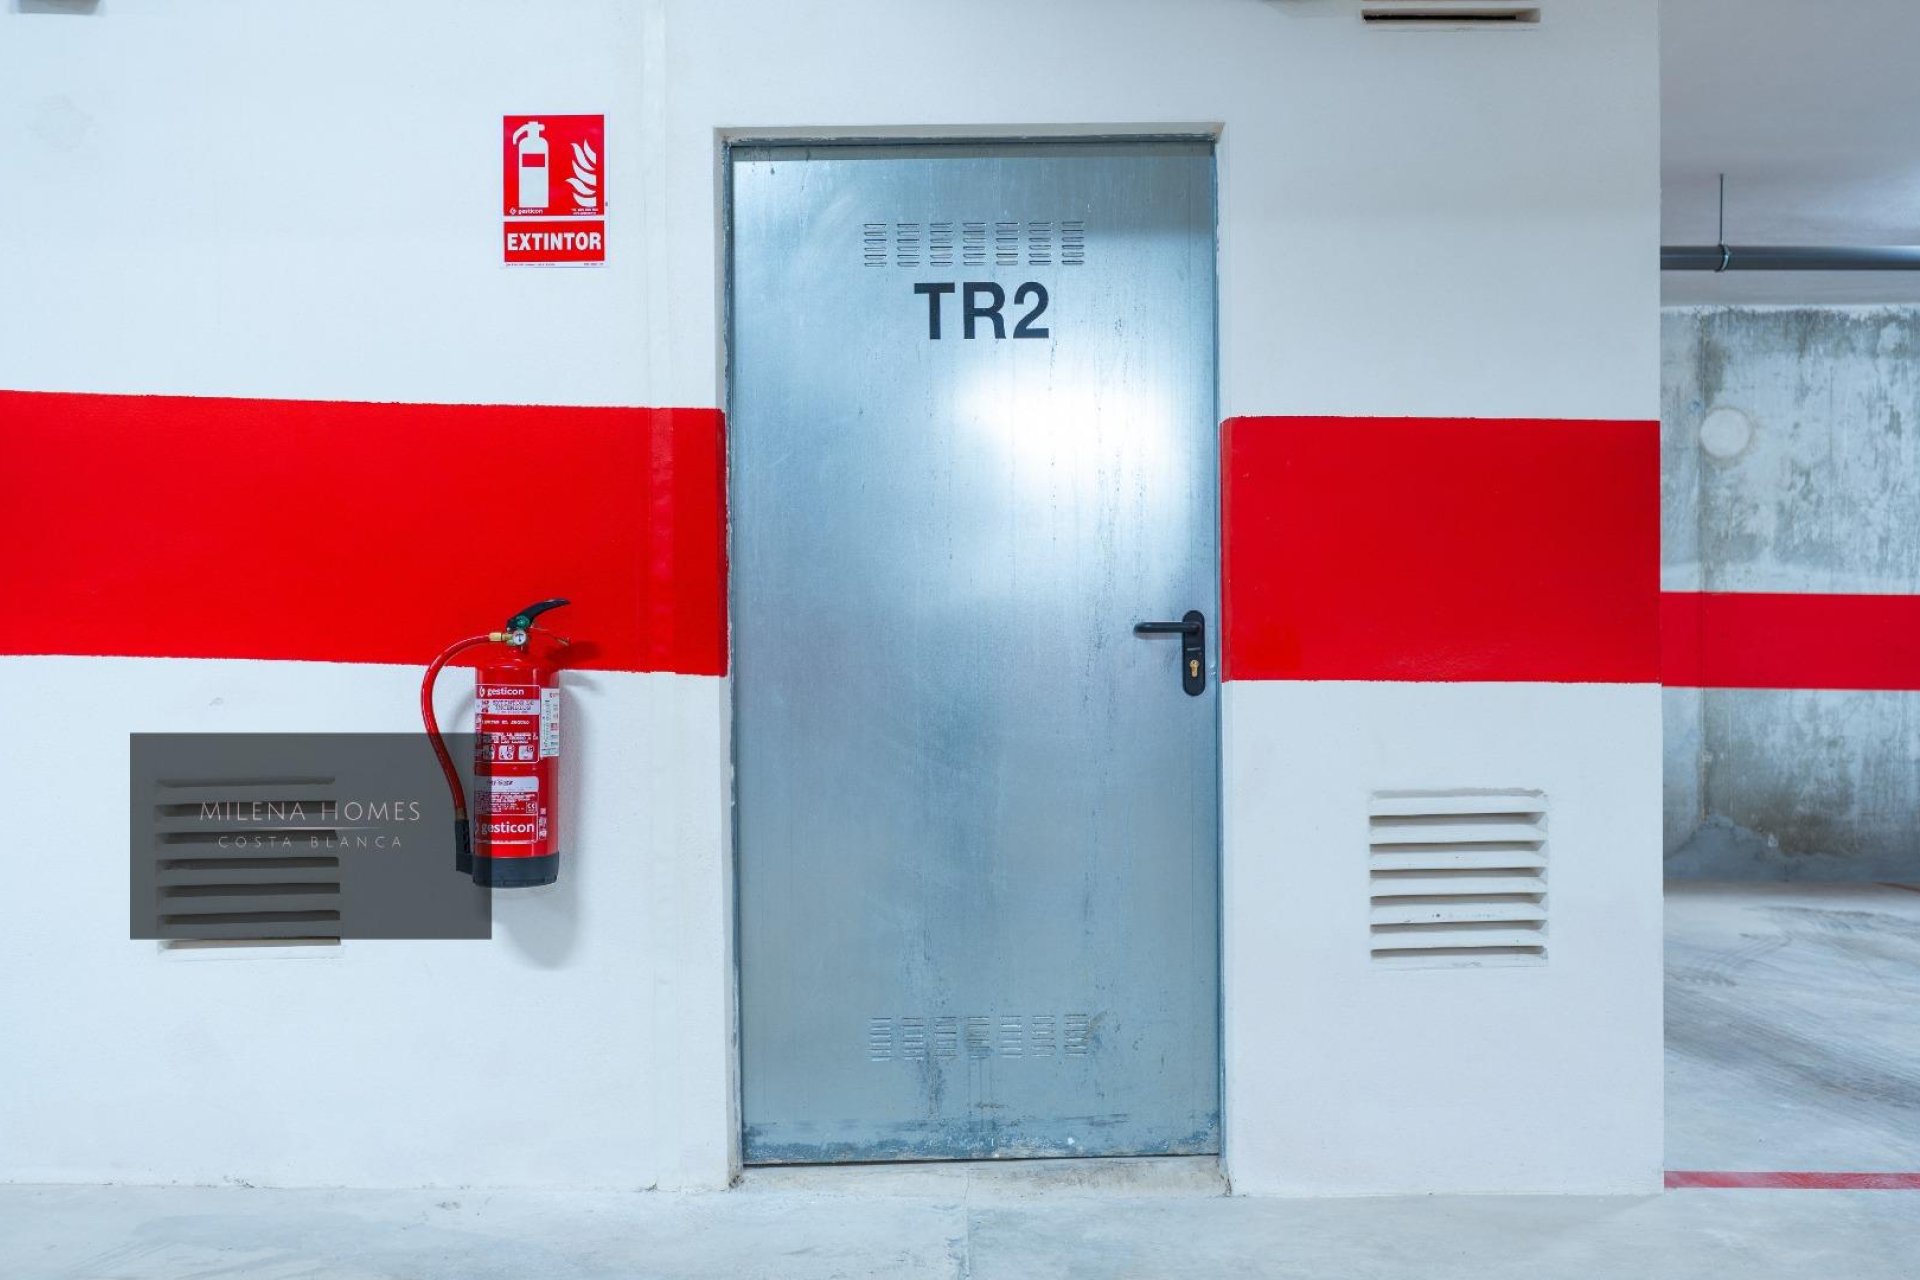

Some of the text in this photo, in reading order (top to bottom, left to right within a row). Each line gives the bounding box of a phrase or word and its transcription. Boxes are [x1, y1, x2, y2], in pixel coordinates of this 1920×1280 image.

[507, 232, 602, 251] EXTINTOR
[914, 281, 1050, 340] TR2
[481, 821, 535, 835] gesticon
